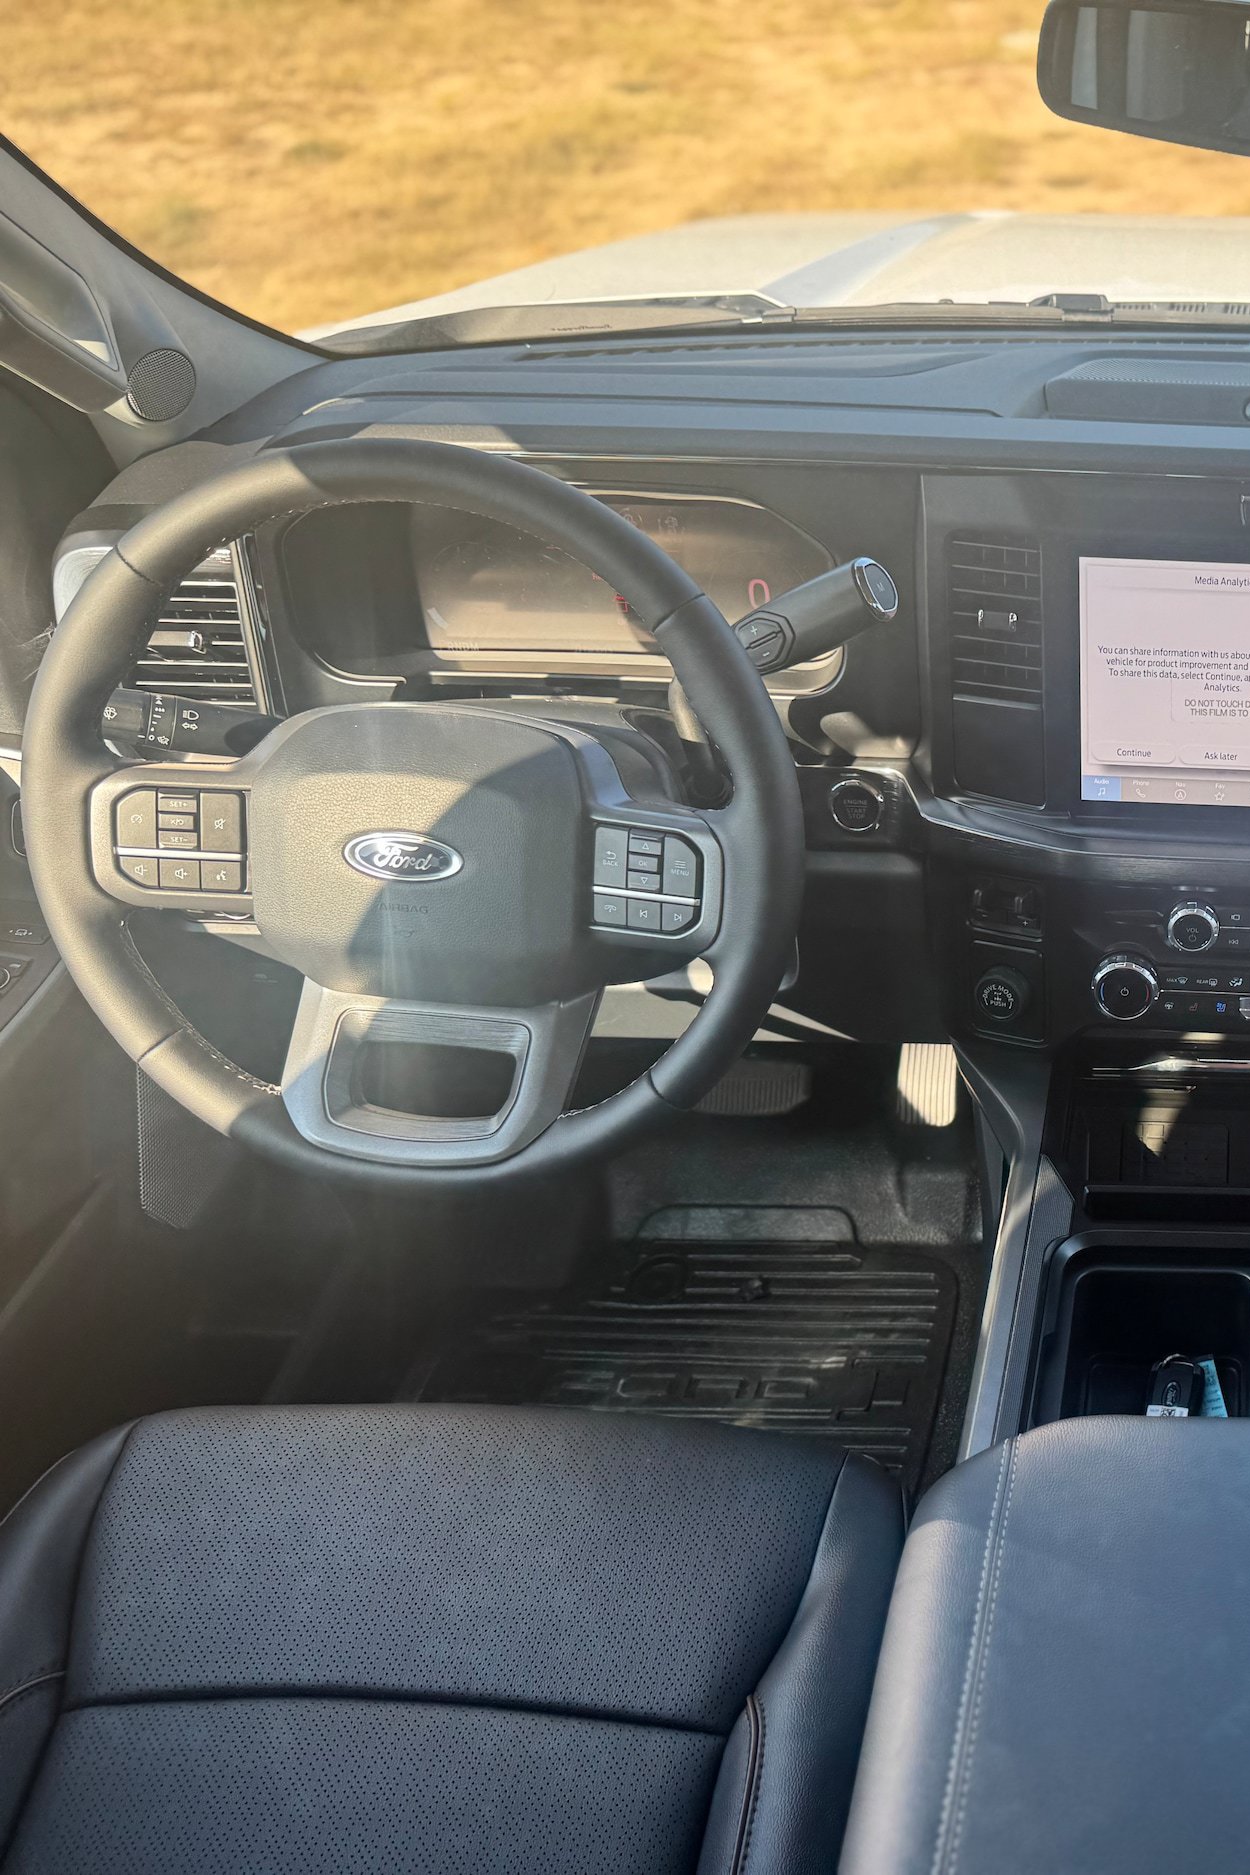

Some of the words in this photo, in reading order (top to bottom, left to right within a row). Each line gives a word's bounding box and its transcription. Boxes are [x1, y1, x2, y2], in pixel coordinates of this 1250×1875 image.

[1194, 576, 1219, 585] Media
[1098, 645, 1114, 655] You
[1114, 647, 1129, 655] can
[1129, 646, 1152, 656] share
[1152, 647, 1200, 658] information
[1201, 650, 1219, 659] with
[1106, 657, 1134, 667] vehicle
[1135, 658, 1146, 667] for
[1147, 659, 1178, 668] product
[1179, 660, 1232, 670] improvement
[1233, 663, 1249, 671] and
[1108, 668, 1119, 677] To
[1119, 668, 1142, 678] share
[1143, 669, 1158, 678] this
[1159, 670, 1180, 680] data,
[1181, 671, 1204, 680] select
[1205, 672, 1243, 682] Continue,
[1184, 699, 1197, 707] DO
[1197, 699, 1215, 708] NOT
[1215, 699, 1244, 708] TOUCH
[1190, 708, 1208, 717] THIS
[1209, 709, 1228, 717] FILM
[1229, 709, 1236, 717] IS
[1238, 709, 1249, 717] TO
[1116, 748, 1152, 758] Continue
[1204, 751, 1219, 760] Ask
[1219, 752, 1238, 761] later
[1093, 777, 1110, 785] Audio
[373, 842, 434, 871] Ford
[602, 859, 619, 867] BACK
[670, 868, 690, 876] MENU
[982, 984, 997, 1000] DRIVE
[997, 985, 1015, 1003] MODE
